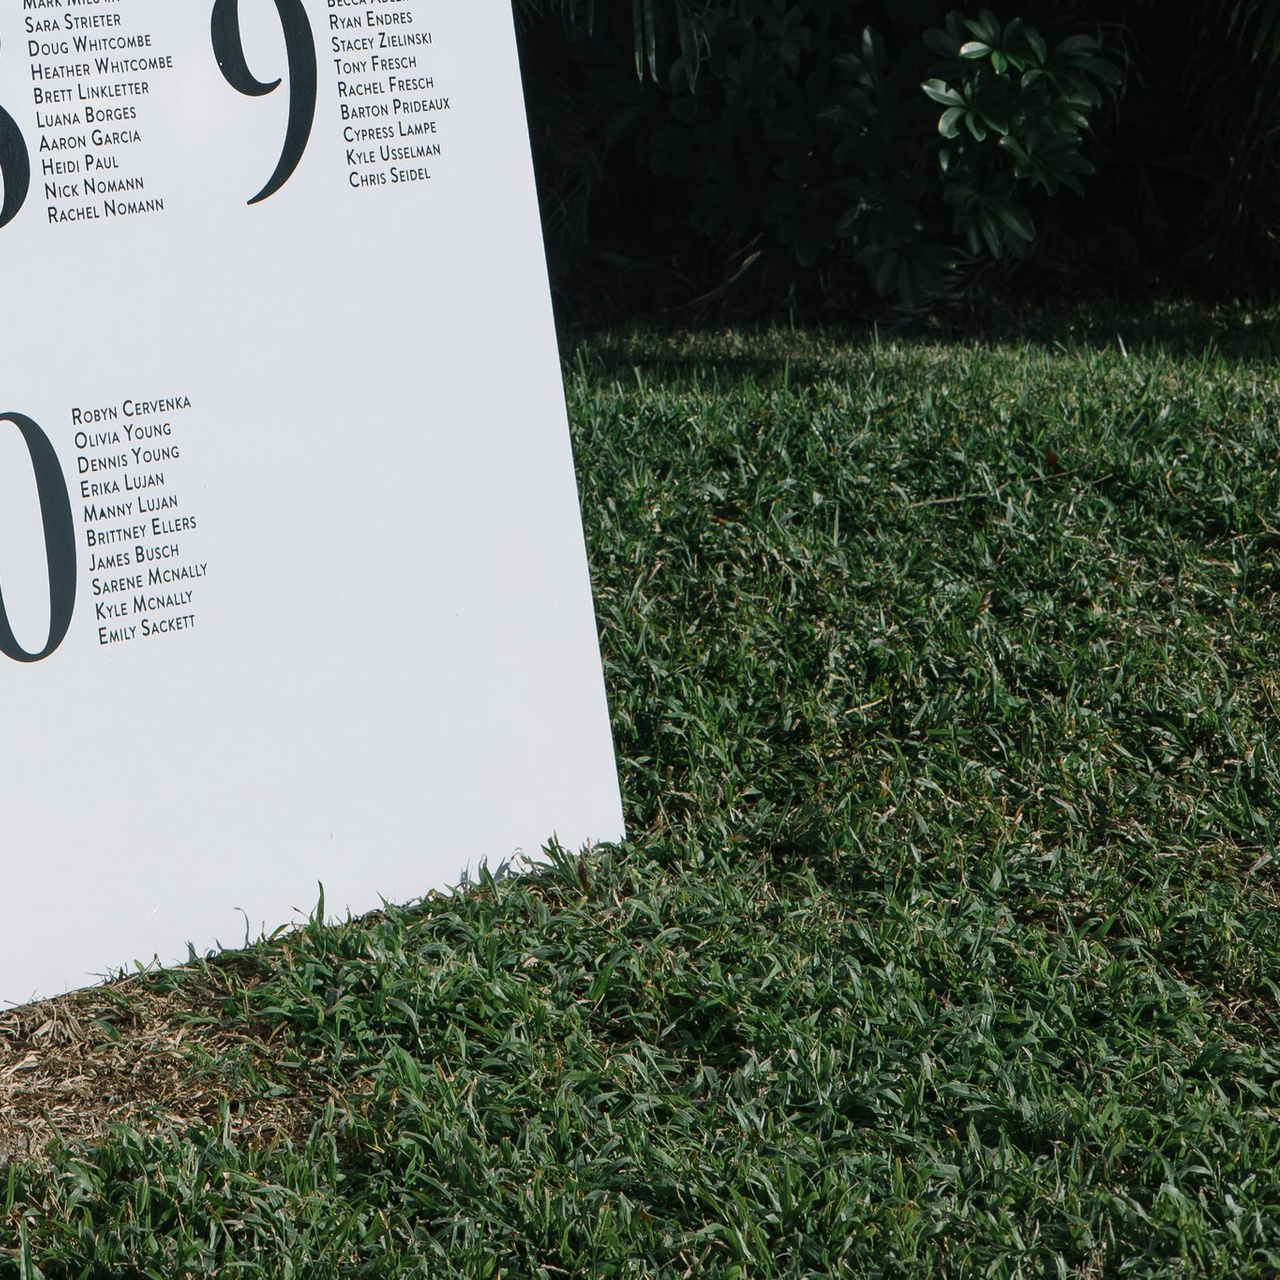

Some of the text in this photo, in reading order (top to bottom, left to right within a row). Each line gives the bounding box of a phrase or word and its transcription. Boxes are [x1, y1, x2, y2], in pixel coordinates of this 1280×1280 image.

[25, 13, 121, 33] SARA STRIETER
[329, 10, 413, 30] RYAN ENDRES
[28, 34, 151, 57] DOUG WHITCOMBE
[34, 82, 149, 104] BRETT LINKLETTER
[337, 76, 434, 98] RACHEL FRESCH
[36, 106, 136, 128] LUANA BORGES
[340, 98, 450, 120] BARTON PRIDEAUX
[39, 129, 141, 152] AARON GARCIA
[343, 121, 437, 143] CYPRESS LAMPE
[42, 154, 119, 176] HEIDI PAUL
[346, 143, 441, 165] KYLE USSELMAN
[349, 167, 431, 188] CHRIS SEIDEL
[48, 198, 164, 224] RACHEL NOMANN
[71, 396, 191, 425] ROBYN CERVENKA
[77, 446, 179, 474] DENNIS YOUNG
[80, 473, 164, 498] ERIKA LUJAN
[86, 516, 196, 547] BRITTNEY ELLERS
[89, 544, 179, 572] JAMES BUSCH
[92, 563, 207, 596] SARENE MCNALLY
[98, 614, 195, 645] EMILY SACKETT
